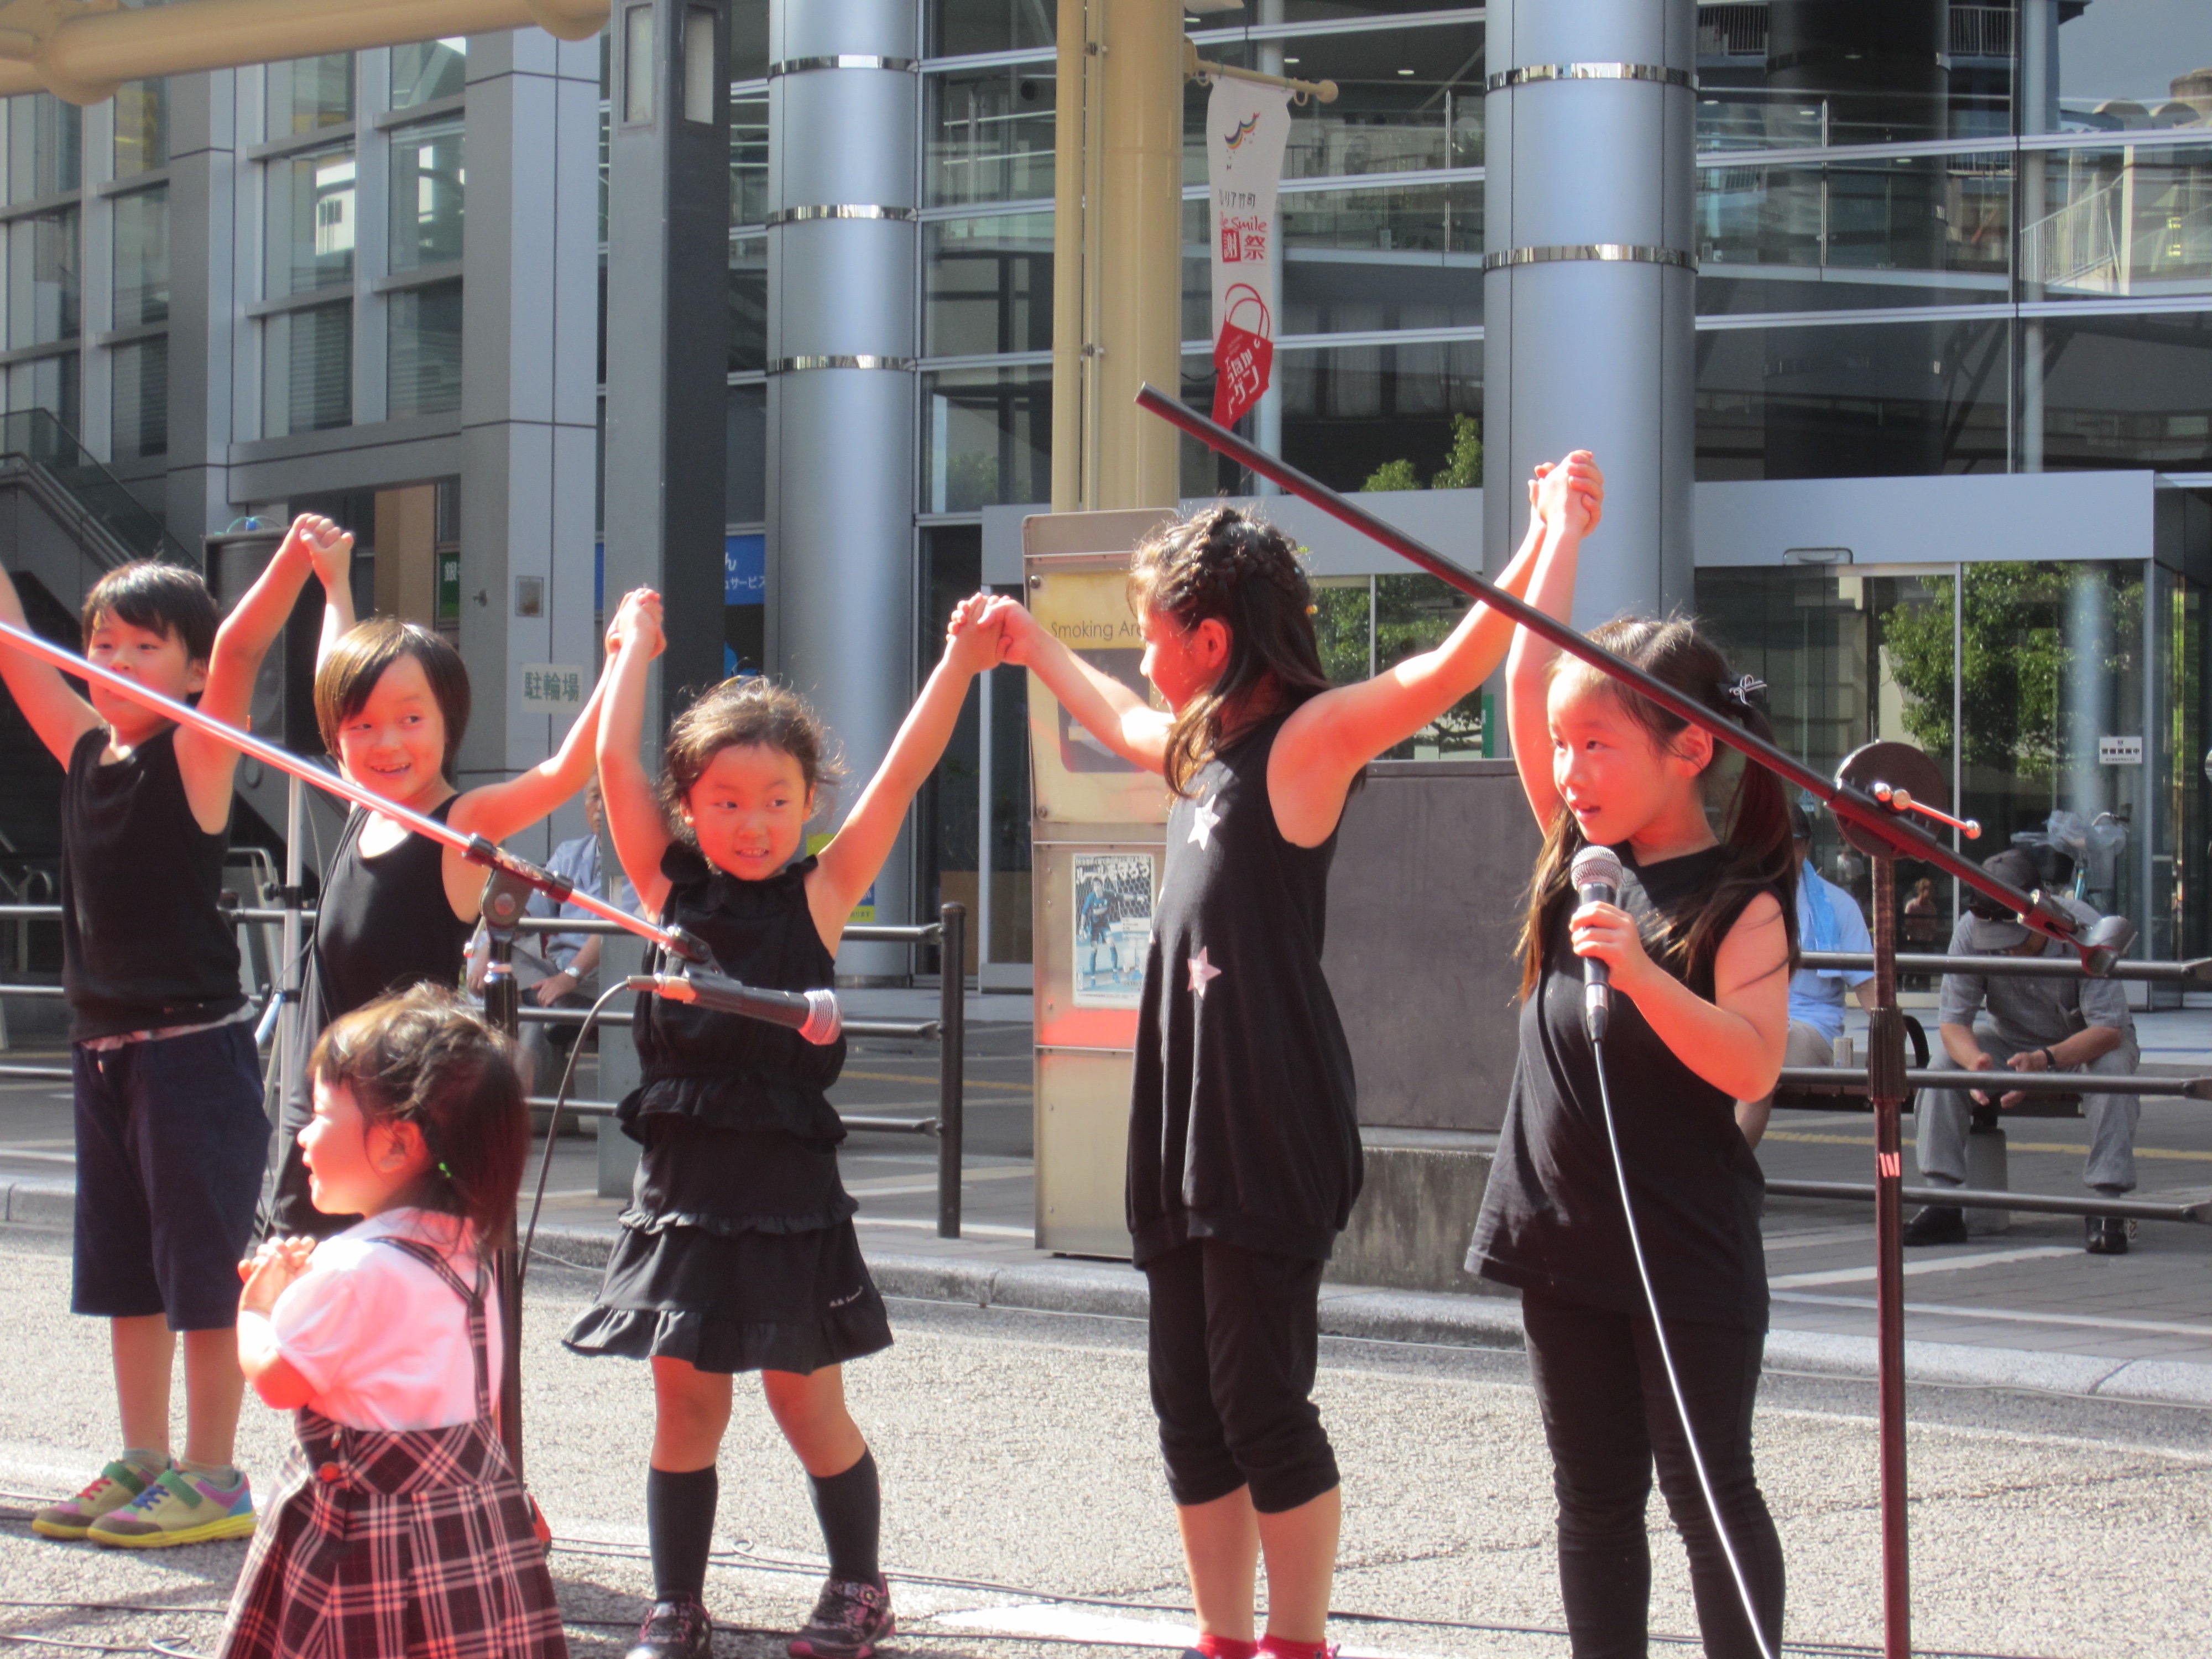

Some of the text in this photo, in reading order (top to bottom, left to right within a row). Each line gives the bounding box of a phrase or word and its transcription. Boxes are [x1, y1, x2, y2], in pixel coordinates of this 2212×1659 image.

[1231, 216, 1267, 232] Smile
[1051, 620, 1113, 641] Smoking
[525, 671, 578, 702] 駐輪場
